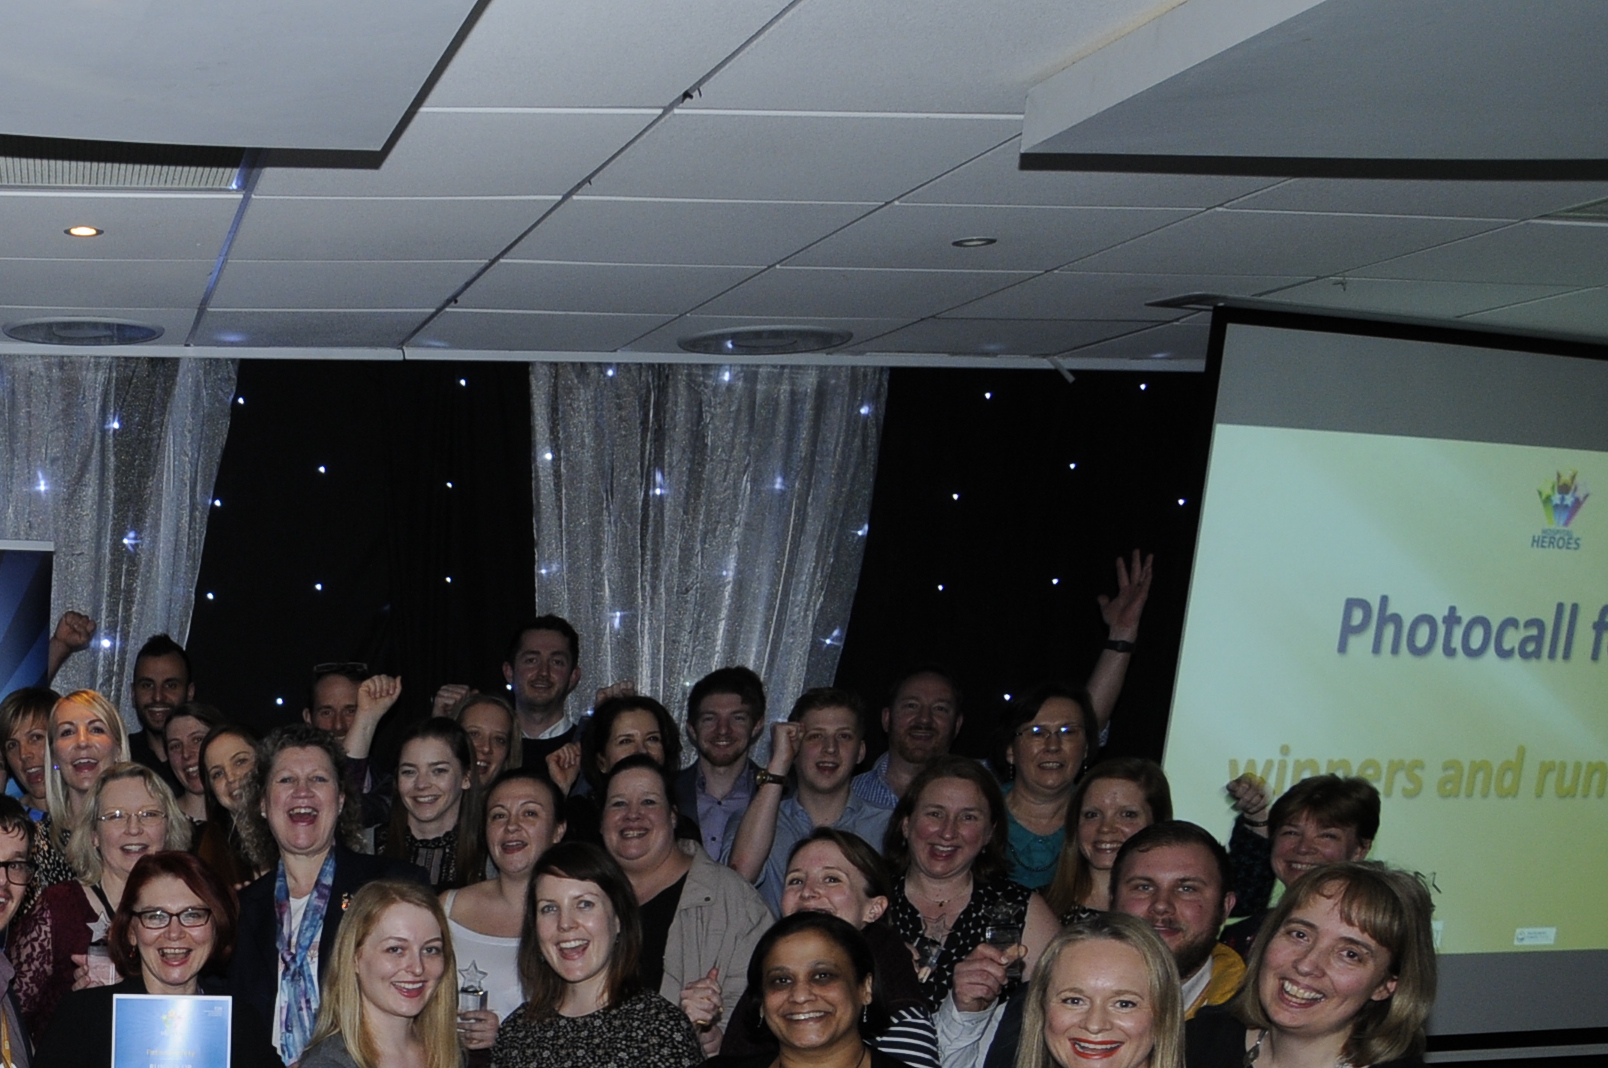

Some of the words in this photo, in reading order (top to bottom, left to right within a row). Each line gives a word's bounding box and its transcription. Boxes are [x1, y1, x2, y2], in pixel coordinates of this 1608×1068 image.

[1531, 535, 1581, 550] HEROES
[1337, 594, 1579, 660] Photocall
[1436, 745, 1526, 799] and
